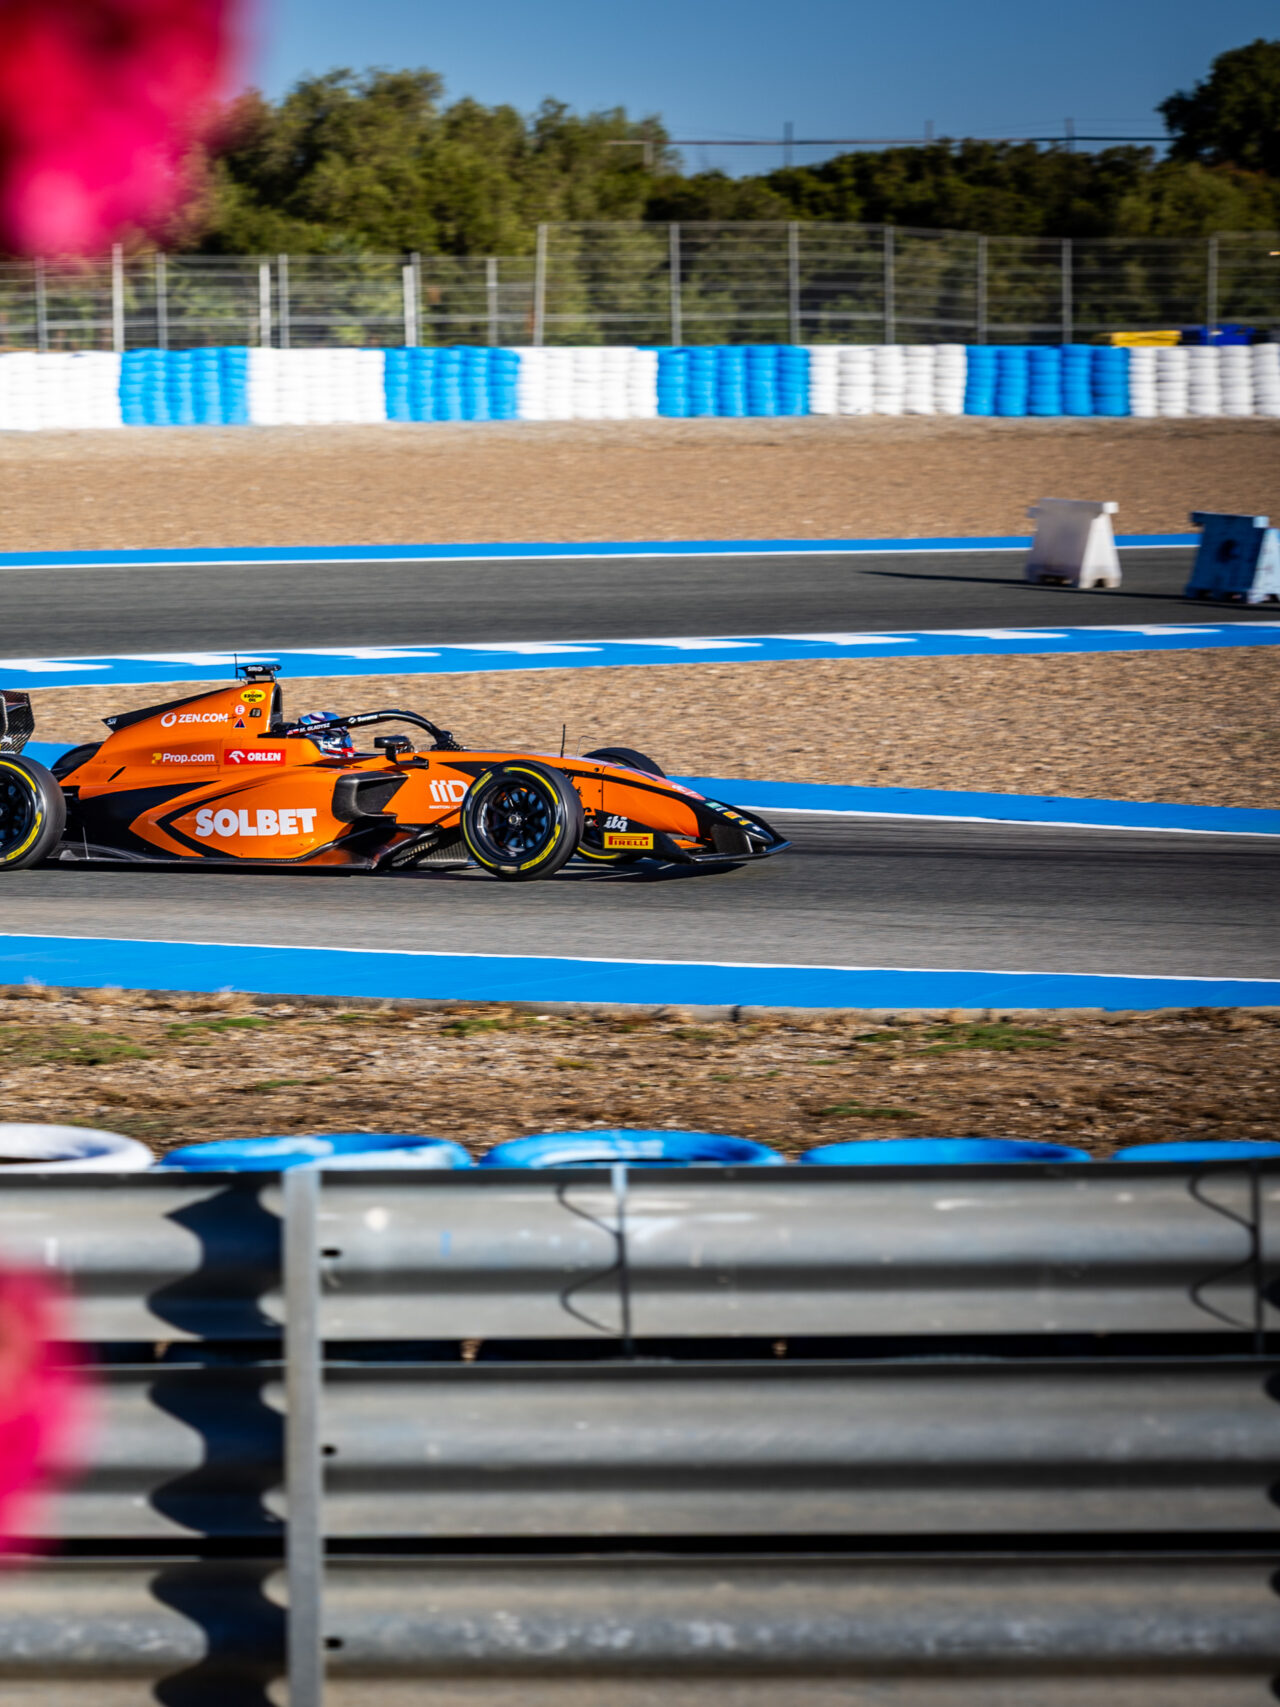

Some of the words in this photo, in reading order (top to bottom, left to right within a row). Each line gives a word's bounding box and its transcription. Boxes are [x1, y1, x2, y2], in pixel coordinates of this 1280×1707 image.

[178, 713, 229, 724] ZEN.COM
[162, 753, 215, 764] Prop.com
[247, 752, 282, 762] ORLEN
[195, 808, 318, 837] SOLBET
[608, 835, 650, 846] PIRELLI
